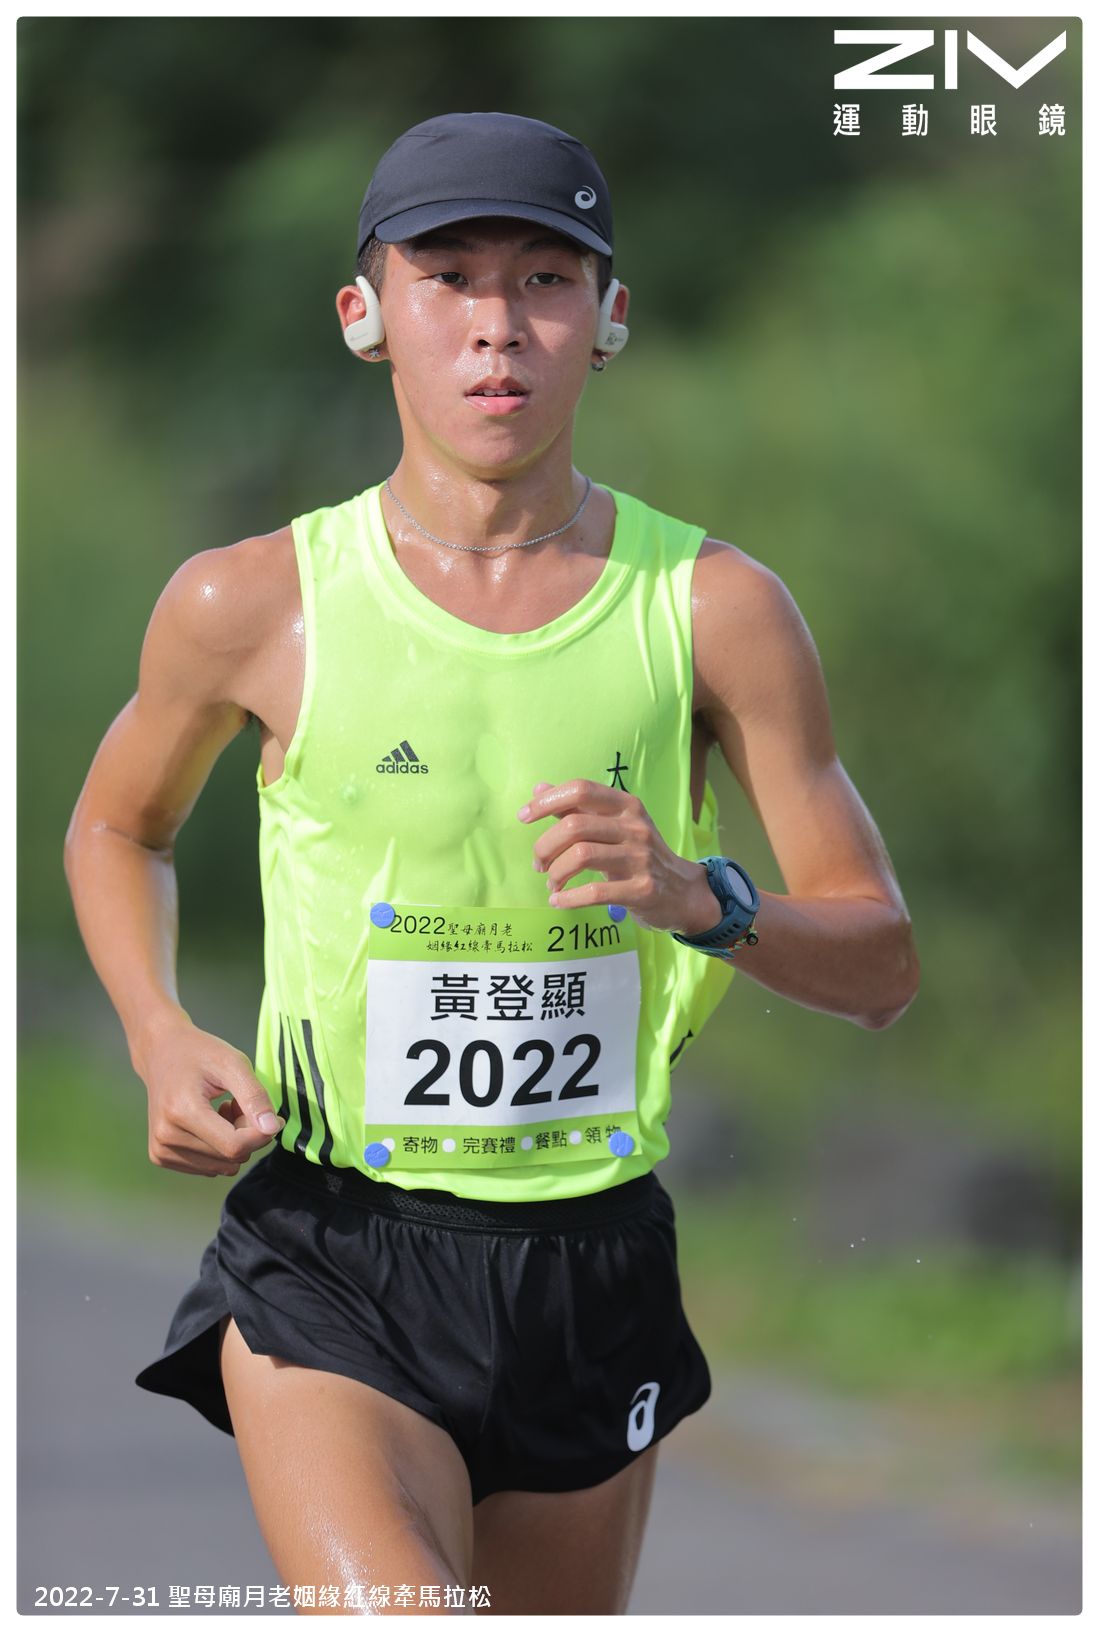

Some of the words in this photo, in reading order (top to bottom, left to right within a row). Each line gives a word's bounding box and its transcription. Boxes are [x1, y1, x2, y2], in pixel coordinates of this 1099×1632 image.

[375, 761, 429, 774] adidas
[547, 923, 621, 952] 21km
[403, 1033, 602, 1108] 2022
[403, 1136, 438, 1154] 寄物
[463, 1136, 516, 1154] 完賽禮
[535, 1130, 568, 1151] 餐點
